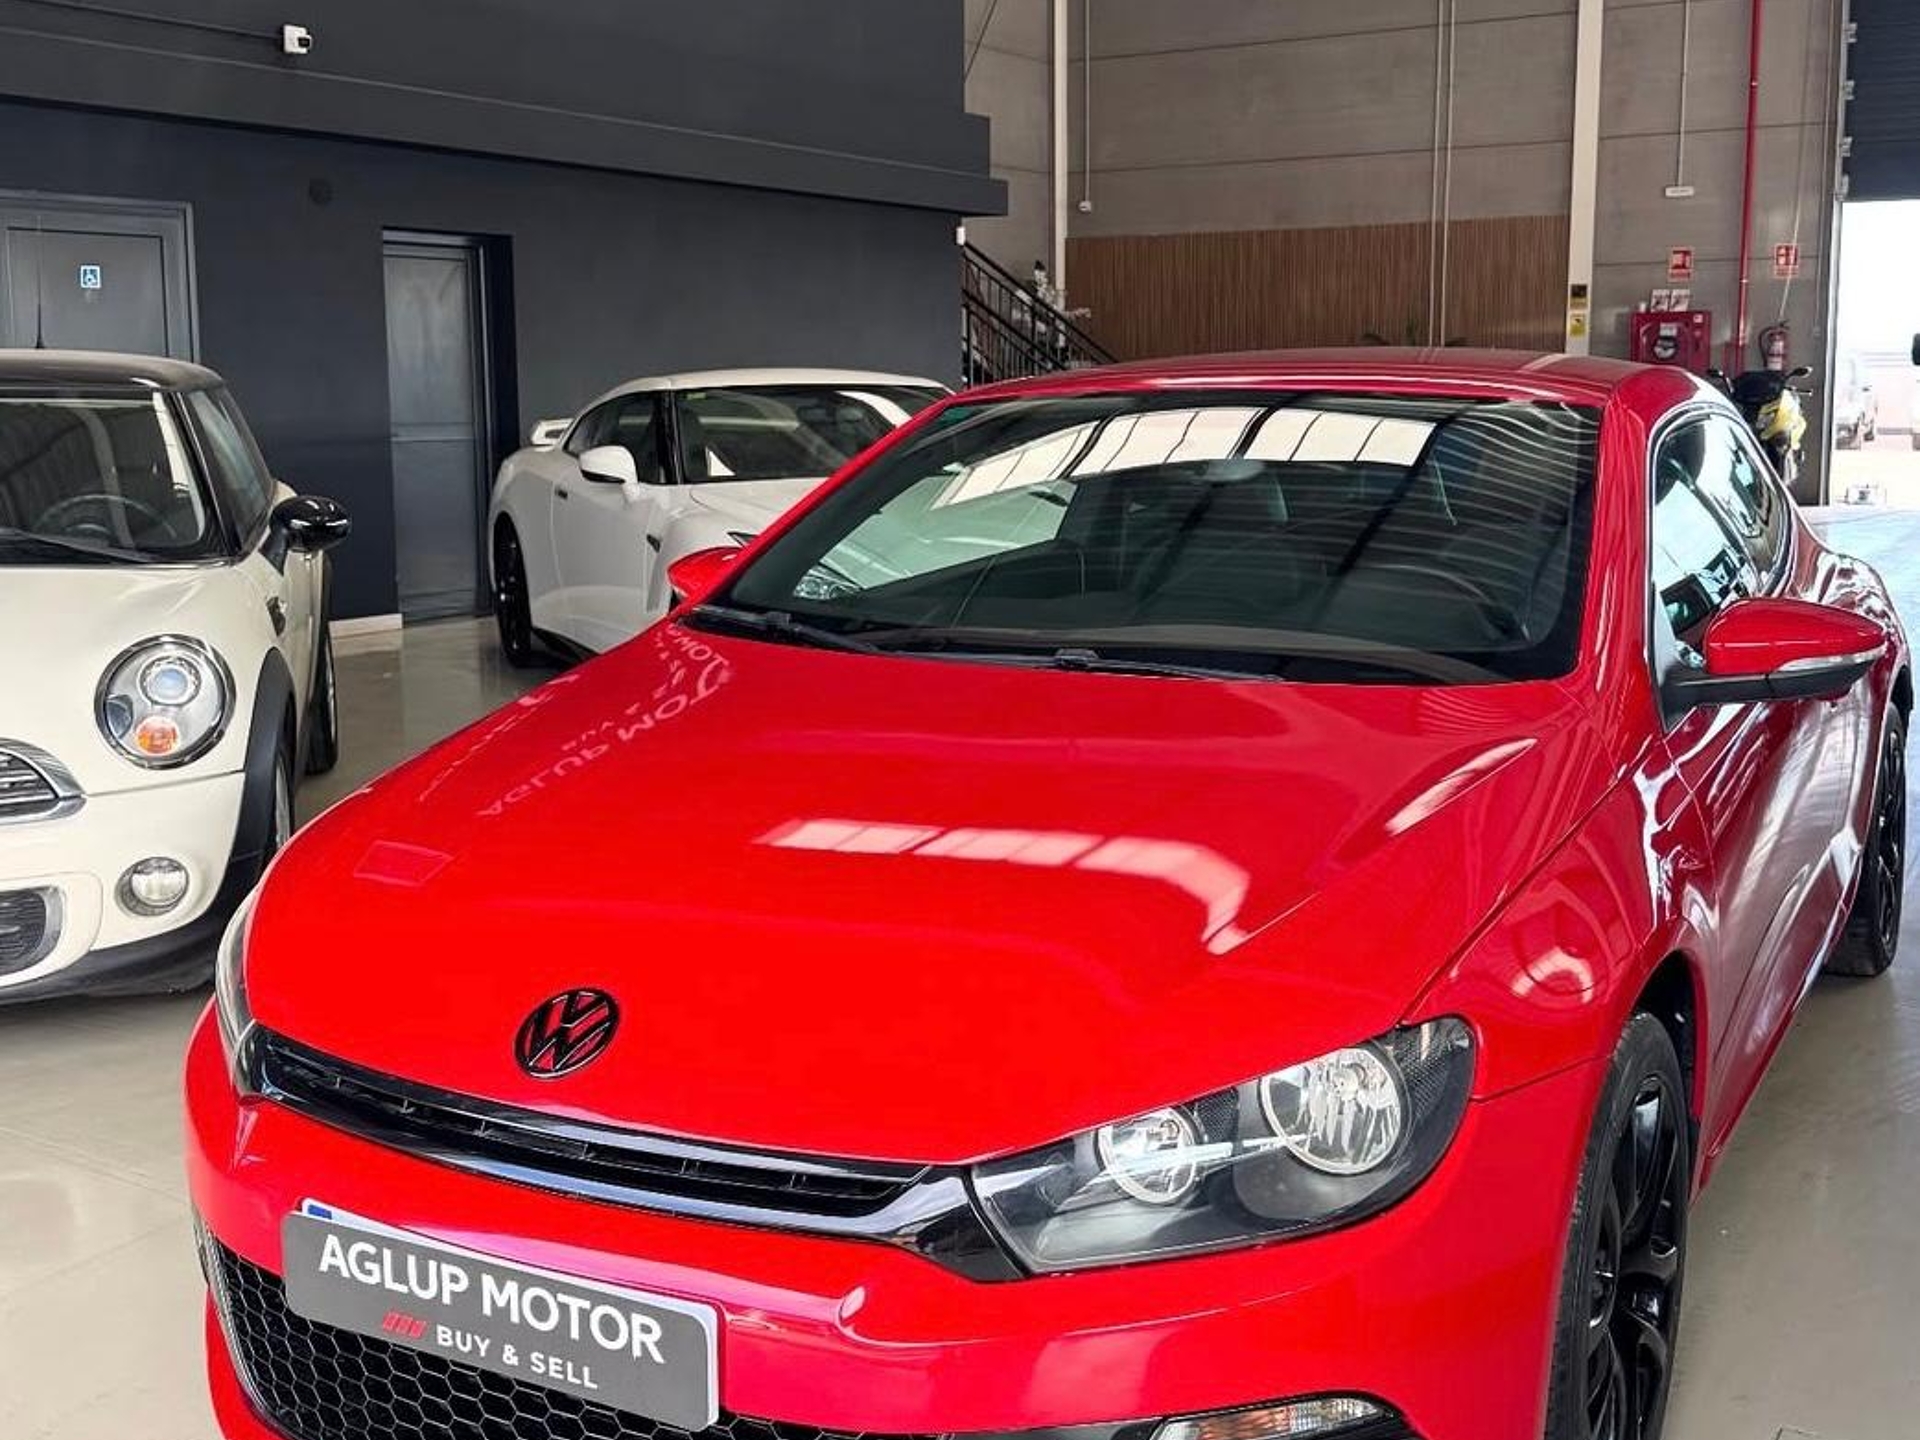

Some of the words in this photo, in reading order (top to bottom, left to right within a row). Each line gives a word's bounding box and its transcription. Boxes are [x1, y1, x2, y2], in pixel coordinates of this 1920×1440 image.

[319, 1233, 469, 1306] AGLUP
[481, 1273, 666, 1364] MOTOR
[436, 1325, 490, 1358] BUY
[502, 1343, 520, 1366] &
[529, 1351, 600, 1390] SELL
